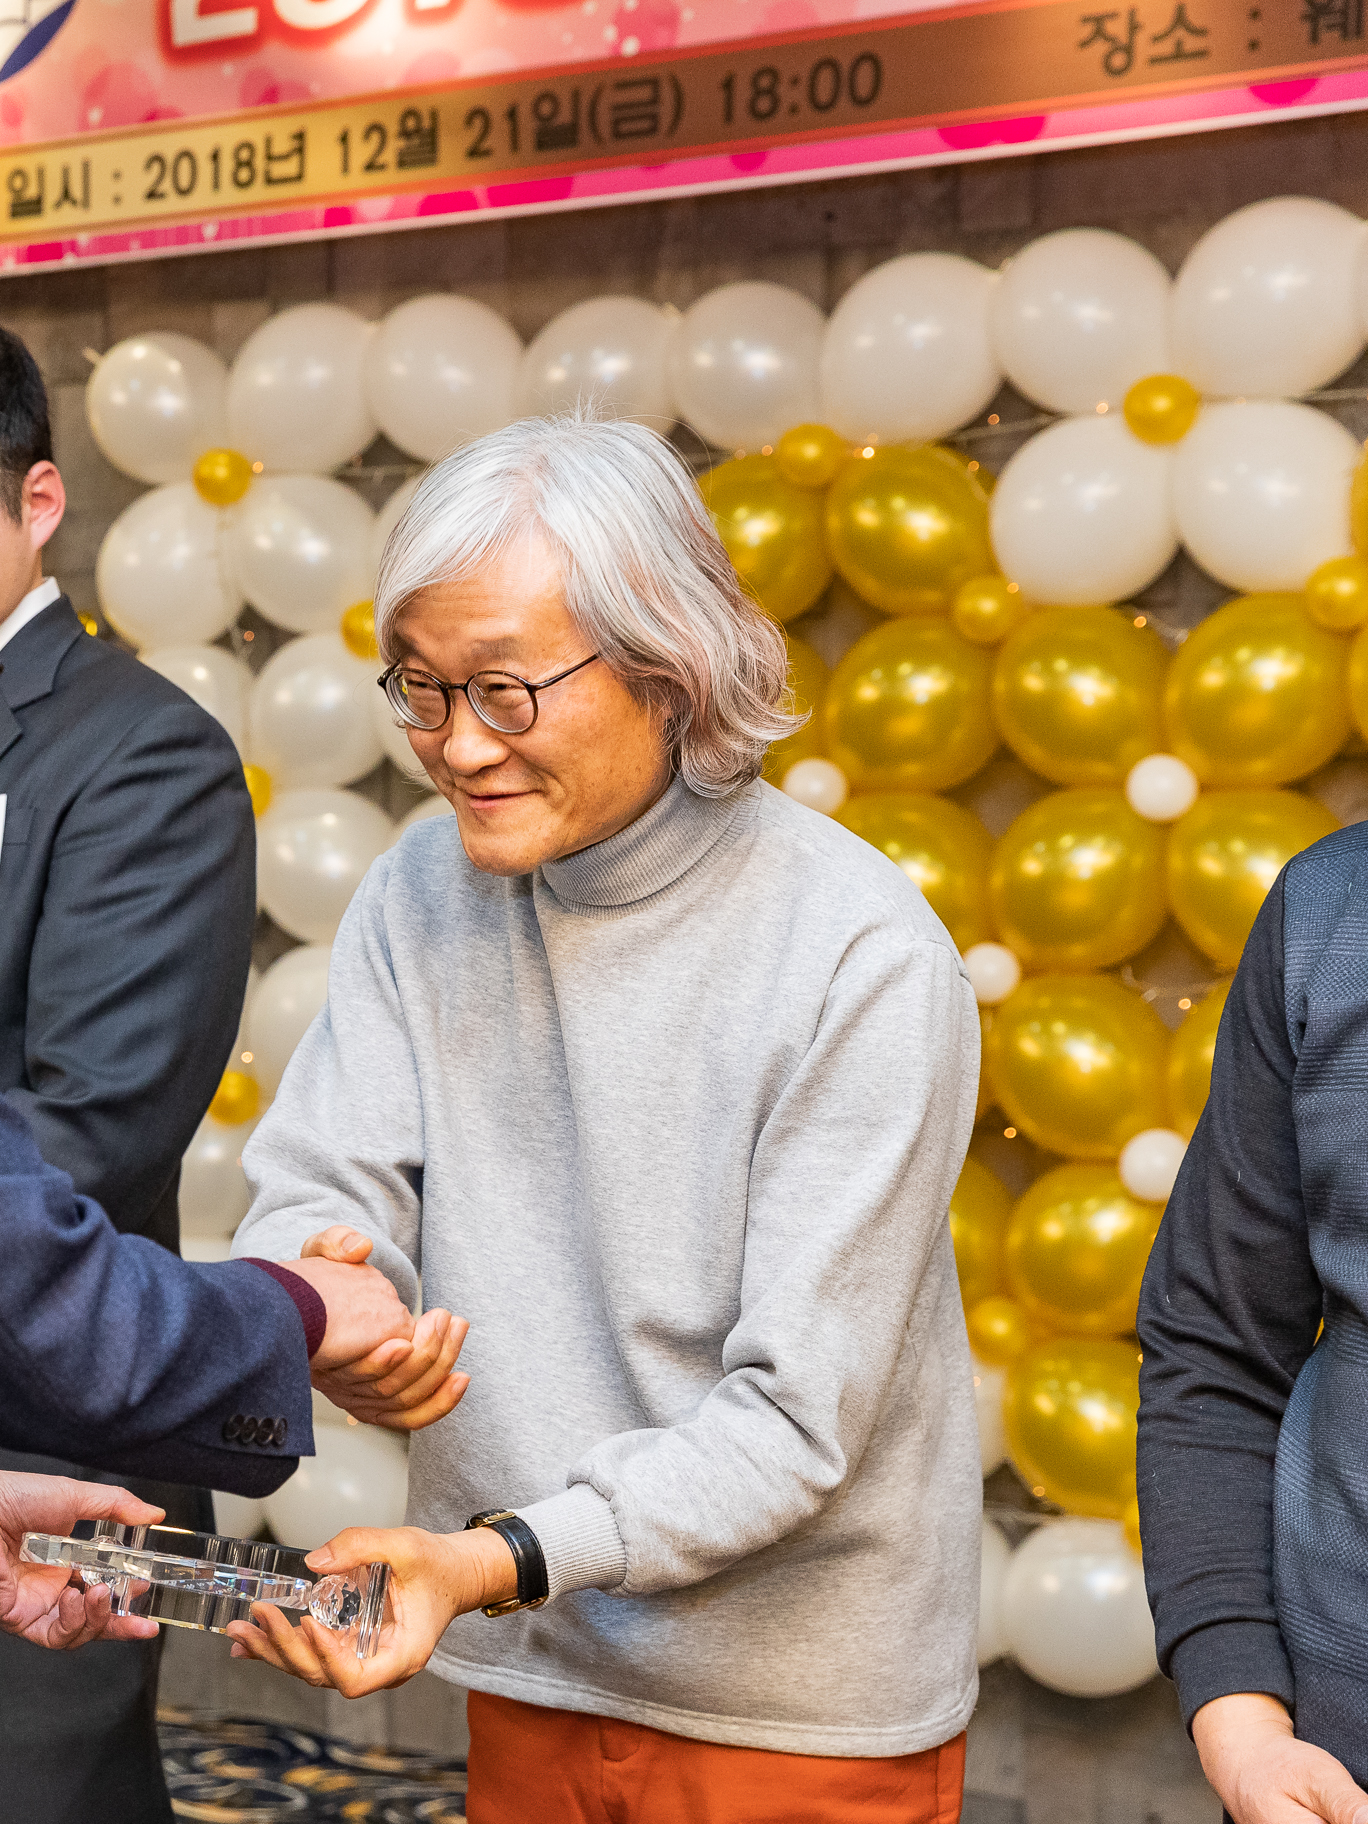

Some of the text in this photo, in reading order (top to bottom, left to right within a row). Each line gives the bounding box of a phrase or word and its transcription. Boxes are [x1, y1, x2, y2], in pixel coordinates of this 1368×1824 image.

[1077, 2, 1211, 78] 장소
[6, 156, 93, 221] 일시
[142, 127, 308, 202] 2018년
[336, 106, 441, 177] 12월
[463, 72, 684, 161] 21일(금)
[719, 51, 883, 124] 18:00
